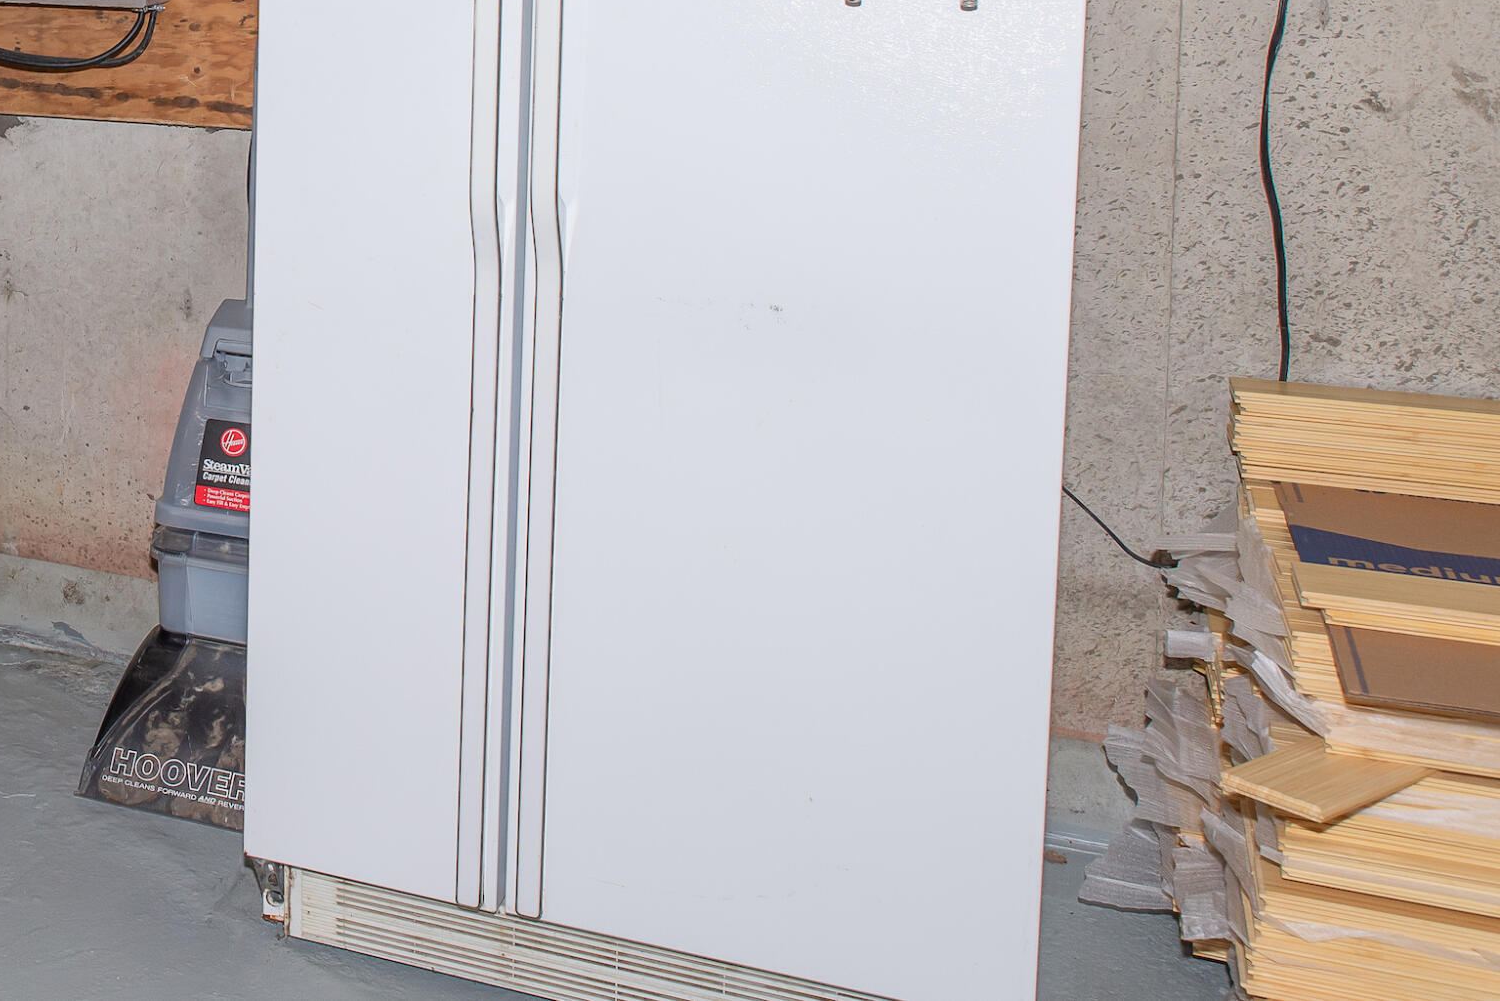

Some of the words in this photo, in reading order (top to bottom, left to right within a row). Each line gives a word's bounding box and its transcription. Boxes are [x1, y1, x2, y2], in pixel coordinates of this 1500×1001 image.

[202, 471, 228, 483] Carpet
[1326, 556, 1500, 586] mediu
[101, 774, 124, 784] DEEP
[124, 779, 156, 792] CLEANS
[157, 786, 197, 800] FORWARD
[198, 795, 216, 804] AND
[109, 747, 245, 802] HOOVER
